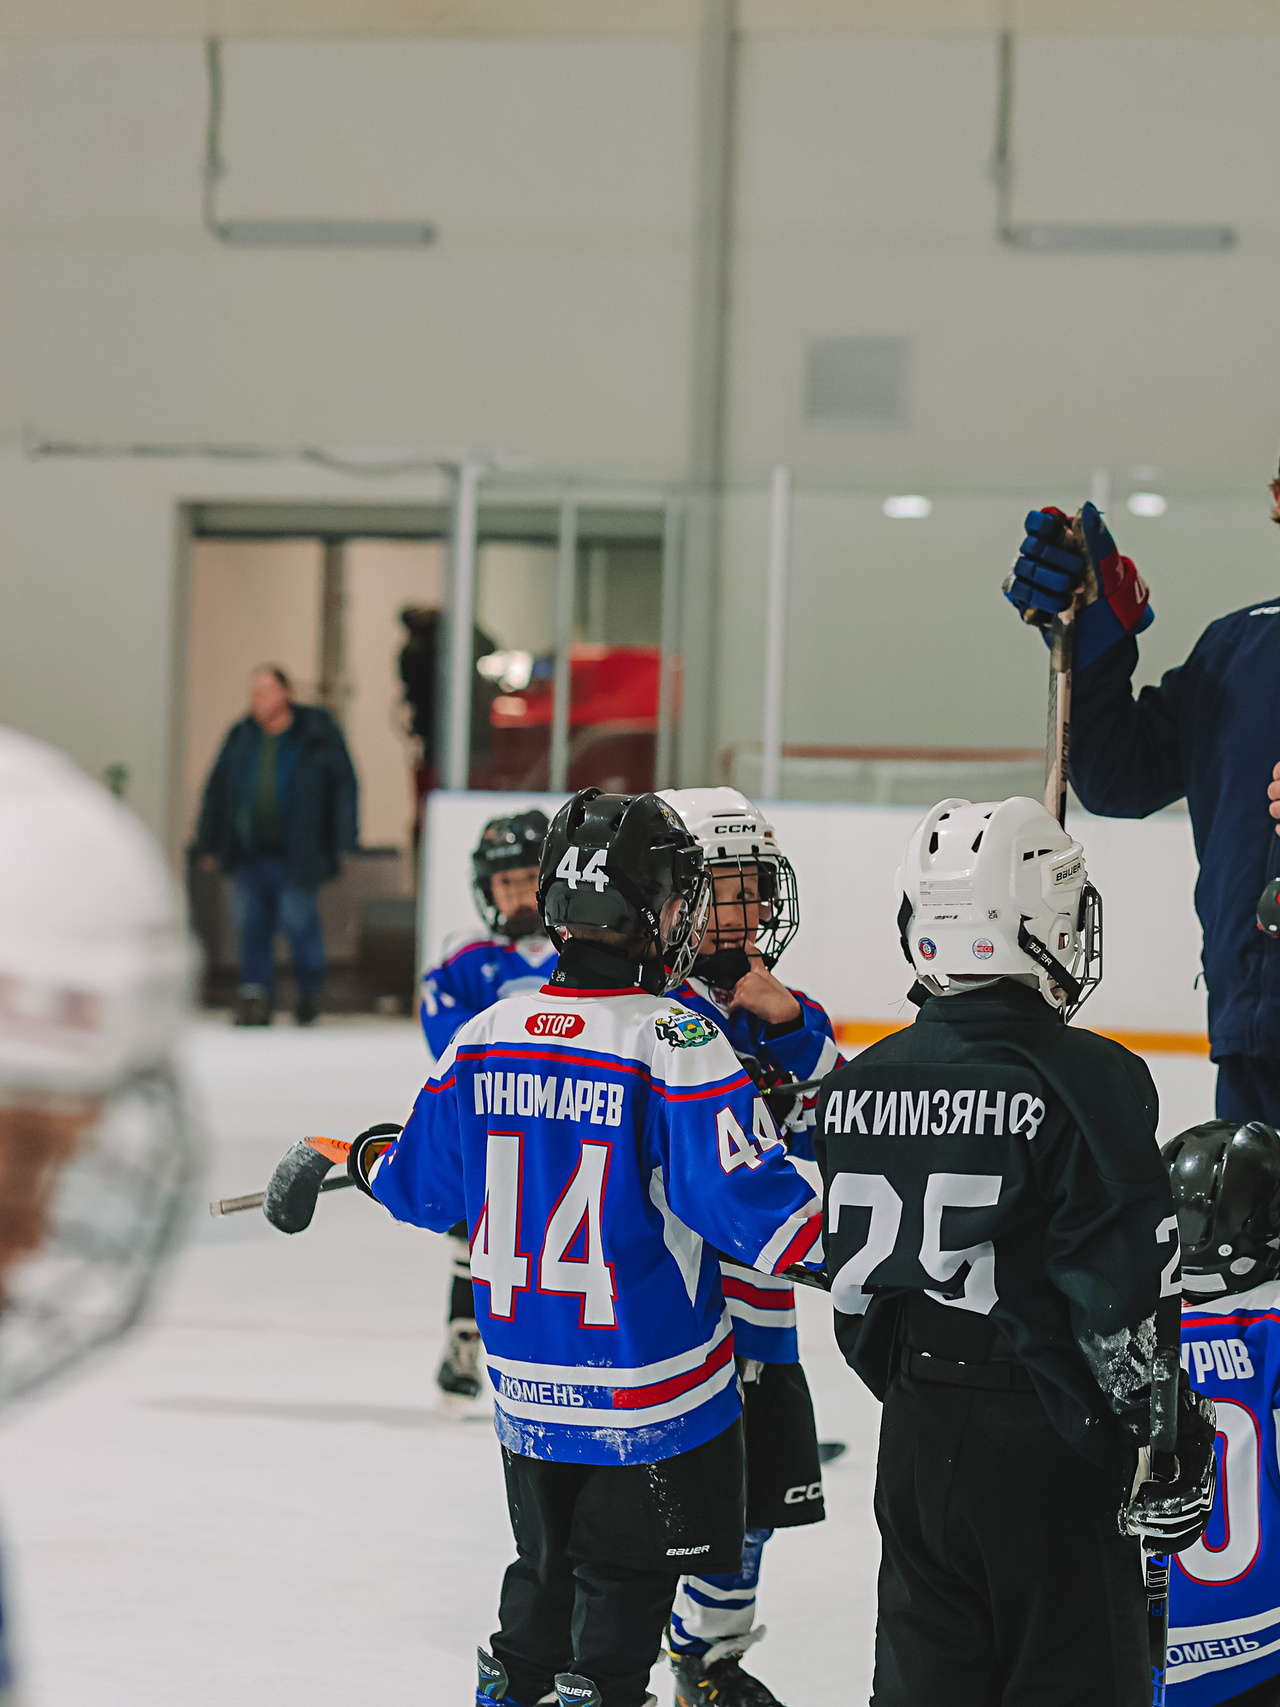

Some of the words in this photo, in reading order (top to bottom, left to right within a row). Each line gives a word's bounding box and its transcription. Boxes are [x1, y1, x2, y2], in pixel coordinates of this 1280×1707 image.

[714, 824, 757, 835] CCM
[555, 846, 610, 893] 44
[1056, 862, 1081, 881] BAUER
[534, 1014, 576, 1035] STOP
[473, 1071, 625, 1127] ПНОМАРЕВ
[715, 1095, 787, 1175] 44
[469, 1130, 618, 1329] 44
[828, 1172, 1003, 1316] 25
[784, 1481, 823, 1504] CC
[666, 1544, 711, 1557] BAUER
